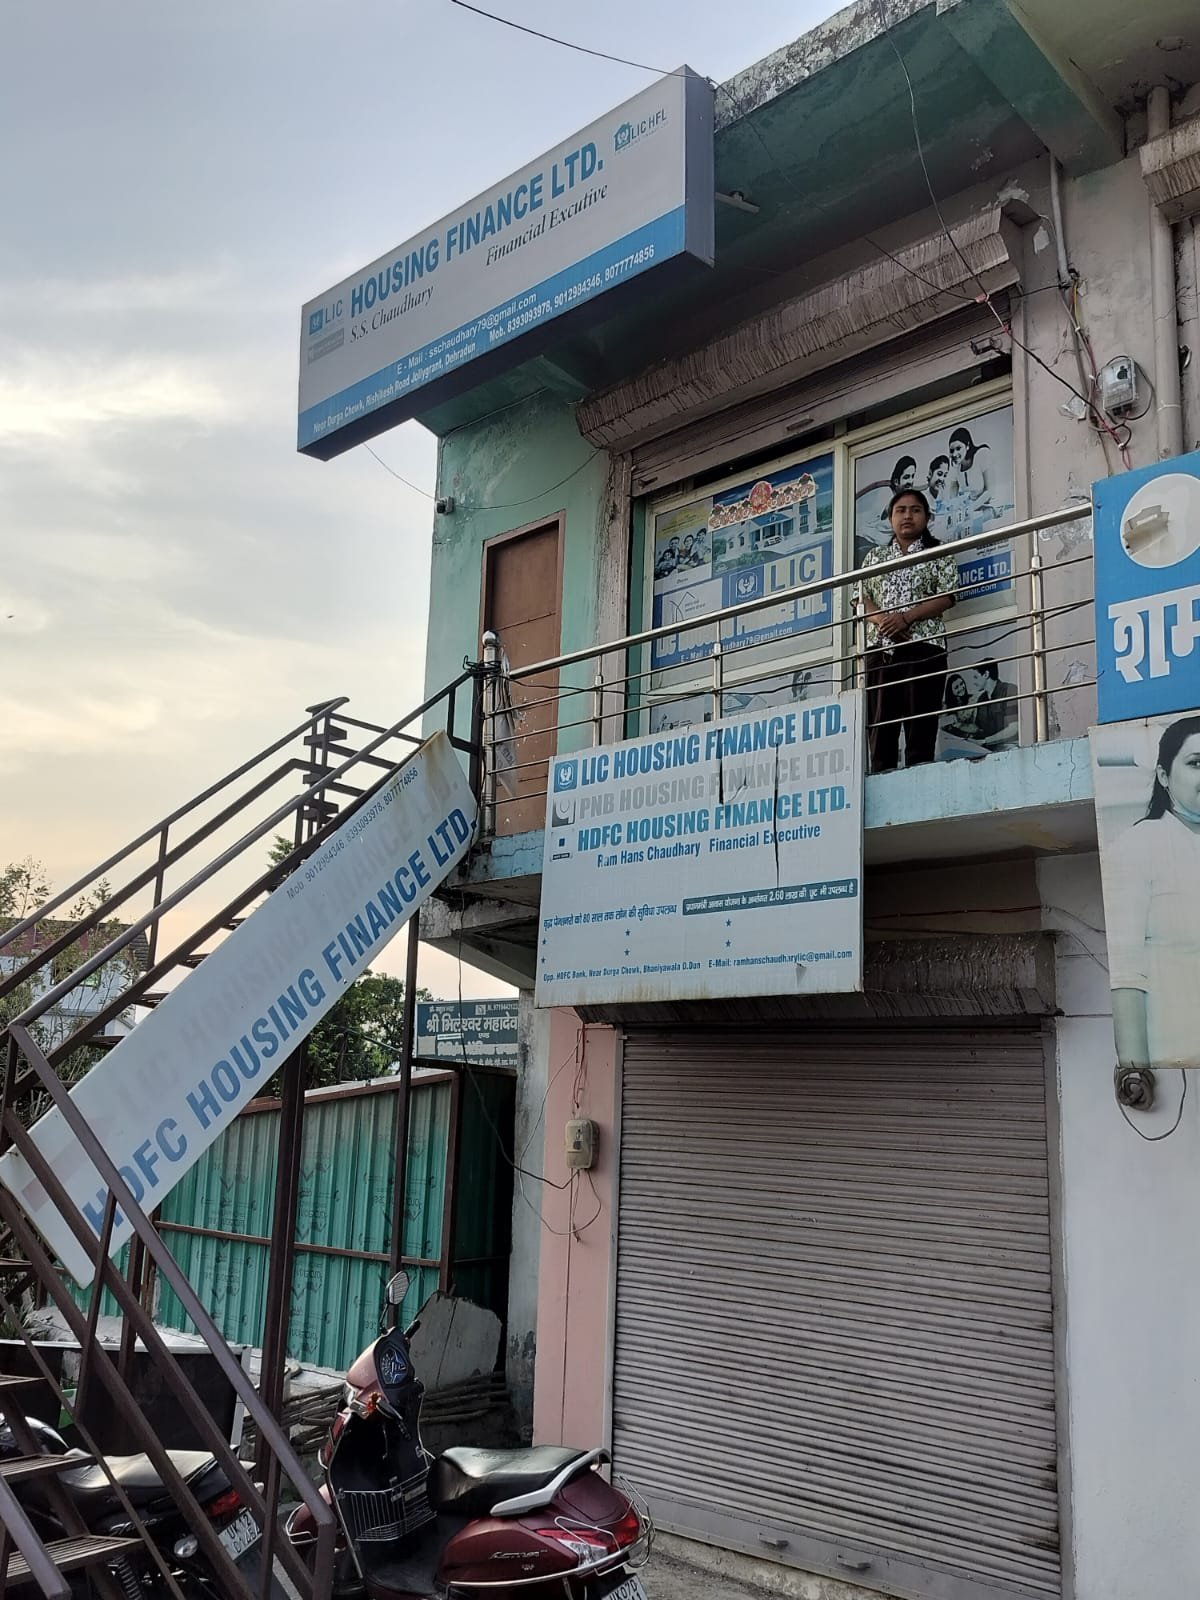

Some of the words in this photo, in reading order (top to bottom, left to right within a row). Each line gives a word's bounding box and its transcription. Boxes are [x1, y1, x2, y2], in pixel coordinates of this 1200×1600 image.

[632, 121, 647, 139] LIC
[648, 109, 667, 129] HFL
[325, 300, 343, 324] LIC
[351, 239, 440, 318] HOUSING
[446, 173, 543, 262] FINANCE
[552, 142, 603, 199] LTD.
[486, 215, 546, 265] Financial
[350, 320, 368, 343] S.S.
[372, 286, 433, 331] Chaudhary
[489, 325, 506, 343] Mob.
[507, 299, 553, 334] 8393093978,
[554, 274, 602, 309] 9012984346,
[605, 244, 655, 282] 8077774856
[409, 356, 423, 369] Mail
[429, 292, 536, 357] sschaudhary79@gmail.com
[395, 376, 410, 394] Road
[445, 342, 476, 365] Dehradun
[771, 553, 816, 591] LIC
[988, 562, 1010, 578] LTD.
[582, 754, 609, 786] LIC
[613, 734, 699, 779] HOUSING
[705, 714, 796, 761] FINANCE
[803, 704, 847, 741] LTD.
[383, 767, 418, 806] 8077774856
[580, 792, 614, 819] PNB
[620, 775, 705, 812] HOUSING
[709, 758, 800, 798] FINANCE
[806, 748, 850, 778] LTD.
[578, 824, 621, 852] HDFC
[627, 809, 709, 841] HOUSING
[714, 793, 803, 830] FINANCE
[808, 786, 850, 815] LTD.
[620, 850, 644, 865] Hans
[647, 842, 701, 861] Chaudhary
[709, 832, 759, 852] Financial
[583, 913, 590, 923] 80
[769, 890, 784, 901] 2.60
[186, 968, 325, 1130] HOUSING
[322, 850, 431, 983] FINANCE
[427, 808, 477, 868] LTD.
[589, 969, 602, 978] Near
[603, 968, 620, 977] Durga
[427, 1013, 439, 1033] श्री
[484, 1011, 519, 1032] महादेव
